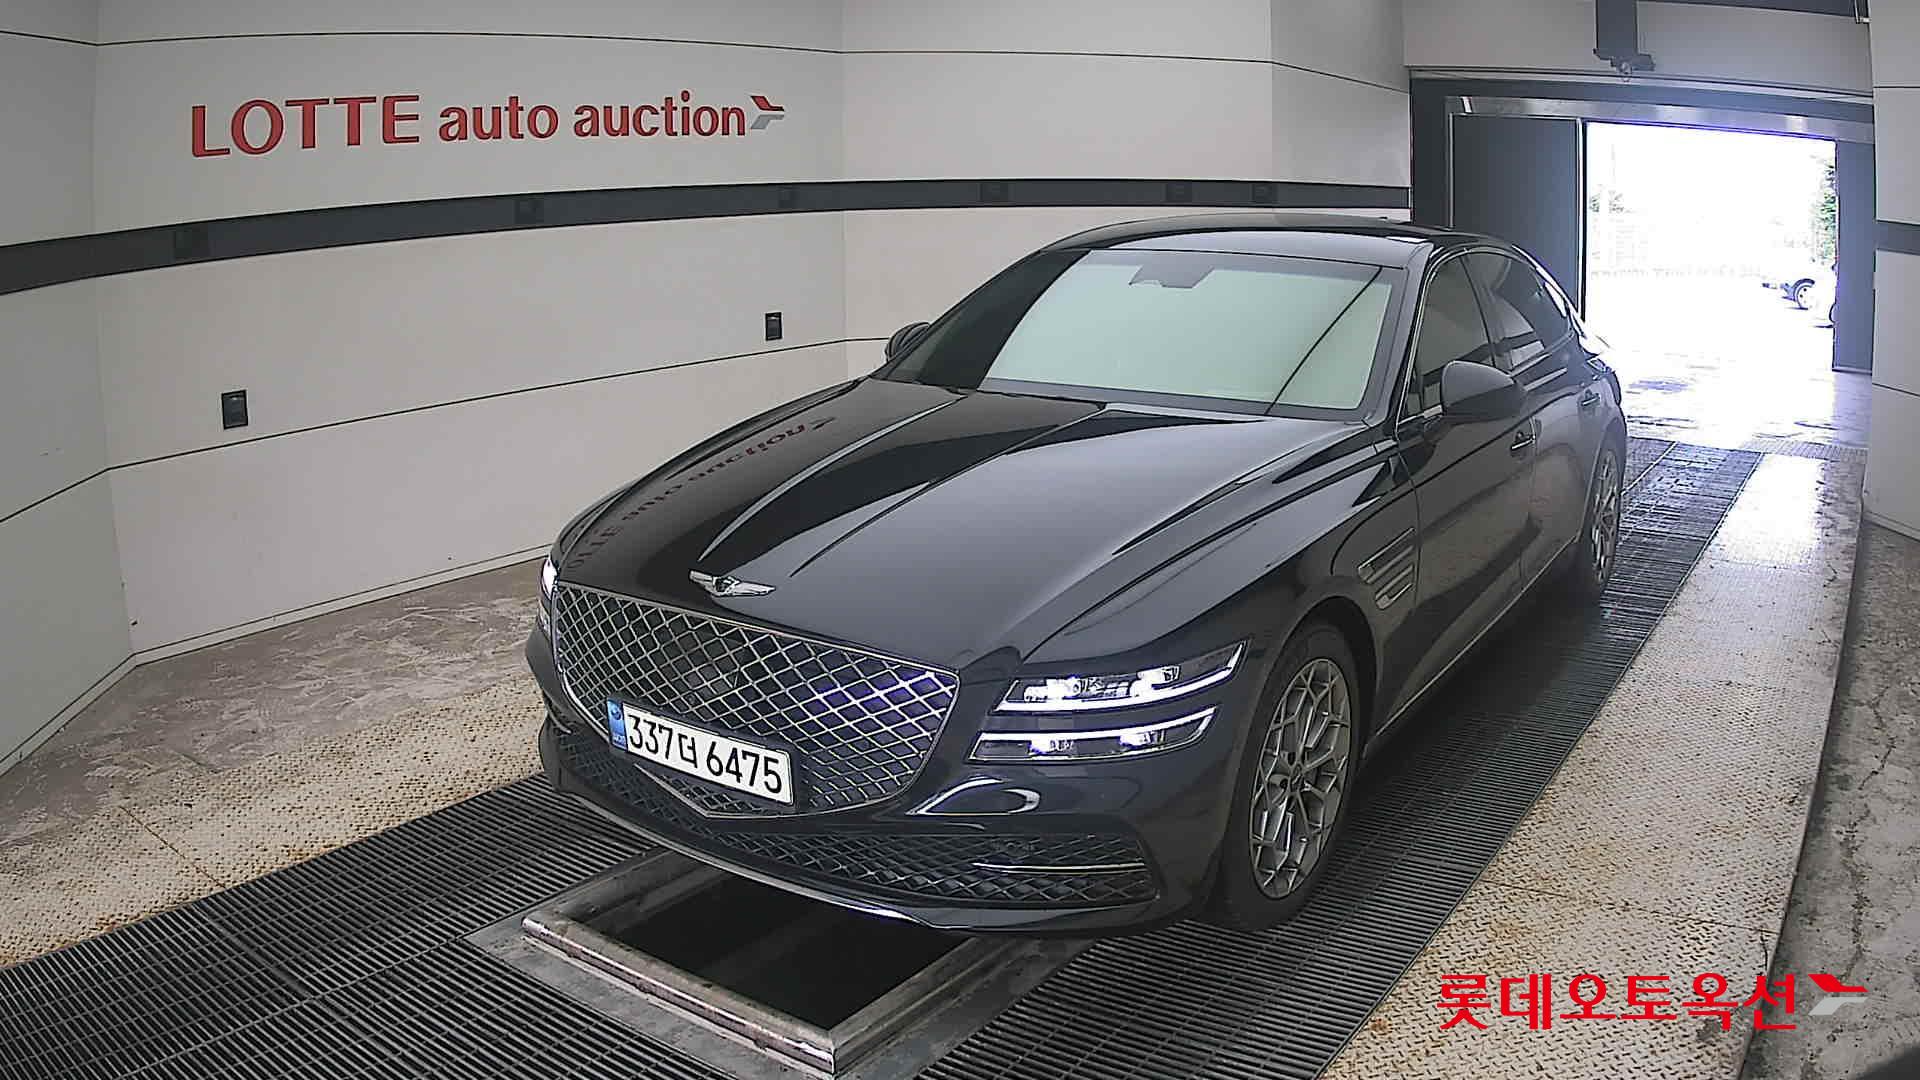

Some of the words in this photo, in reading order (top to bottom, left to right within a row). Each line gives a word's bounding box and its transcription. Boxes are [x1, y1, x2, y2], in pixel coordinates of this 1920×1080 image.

[191, 94, 421, 157] LOTTE
[438, 96, 559, 141] auto
[573, 90, 746, 136] auction
[627, 714, 698, 769] 337더
[706, 741, 782, 794] 6475
